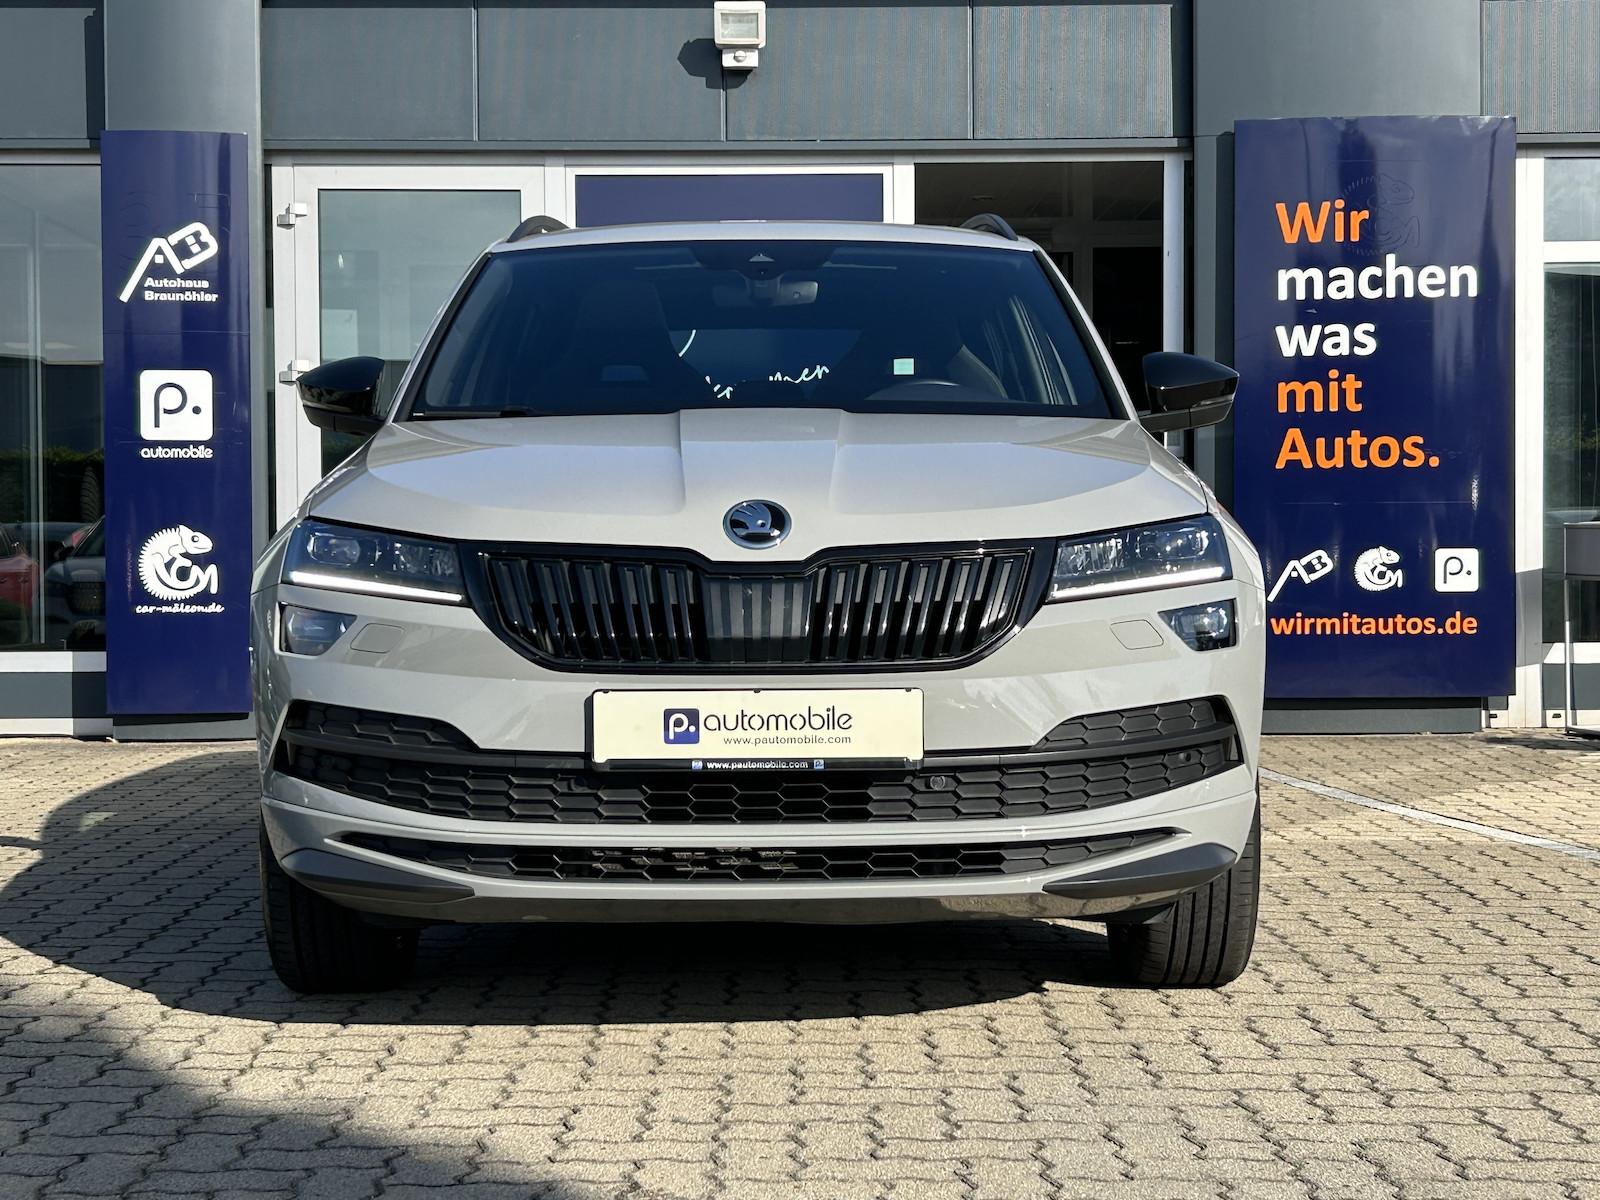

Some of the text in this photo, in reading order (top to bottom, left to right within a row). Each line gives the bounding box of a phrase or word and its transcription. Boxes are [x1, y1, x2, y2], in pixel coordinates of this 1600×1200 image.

[1275, 199, 1369, 244] Wir
[144, 277, 209, 288] Autohaus
[1277, 253, 1478, 301] machen
[144, 290, 219, 302] Braunöhler
[1275, 321, 1377, 357] was
[1277, 369, 1362, 413] mit
[140, 444, 213, 459] automobile
[1275, 428, 1440, 469] Autos.
[1270, 611, 1478, 635] wirmitautos.de
[703, 705, 852, 731] automobile
[723, 734, 851, 746] www.pautomobile.com
[706, 760, 809, 770] www.pautomobile.com
